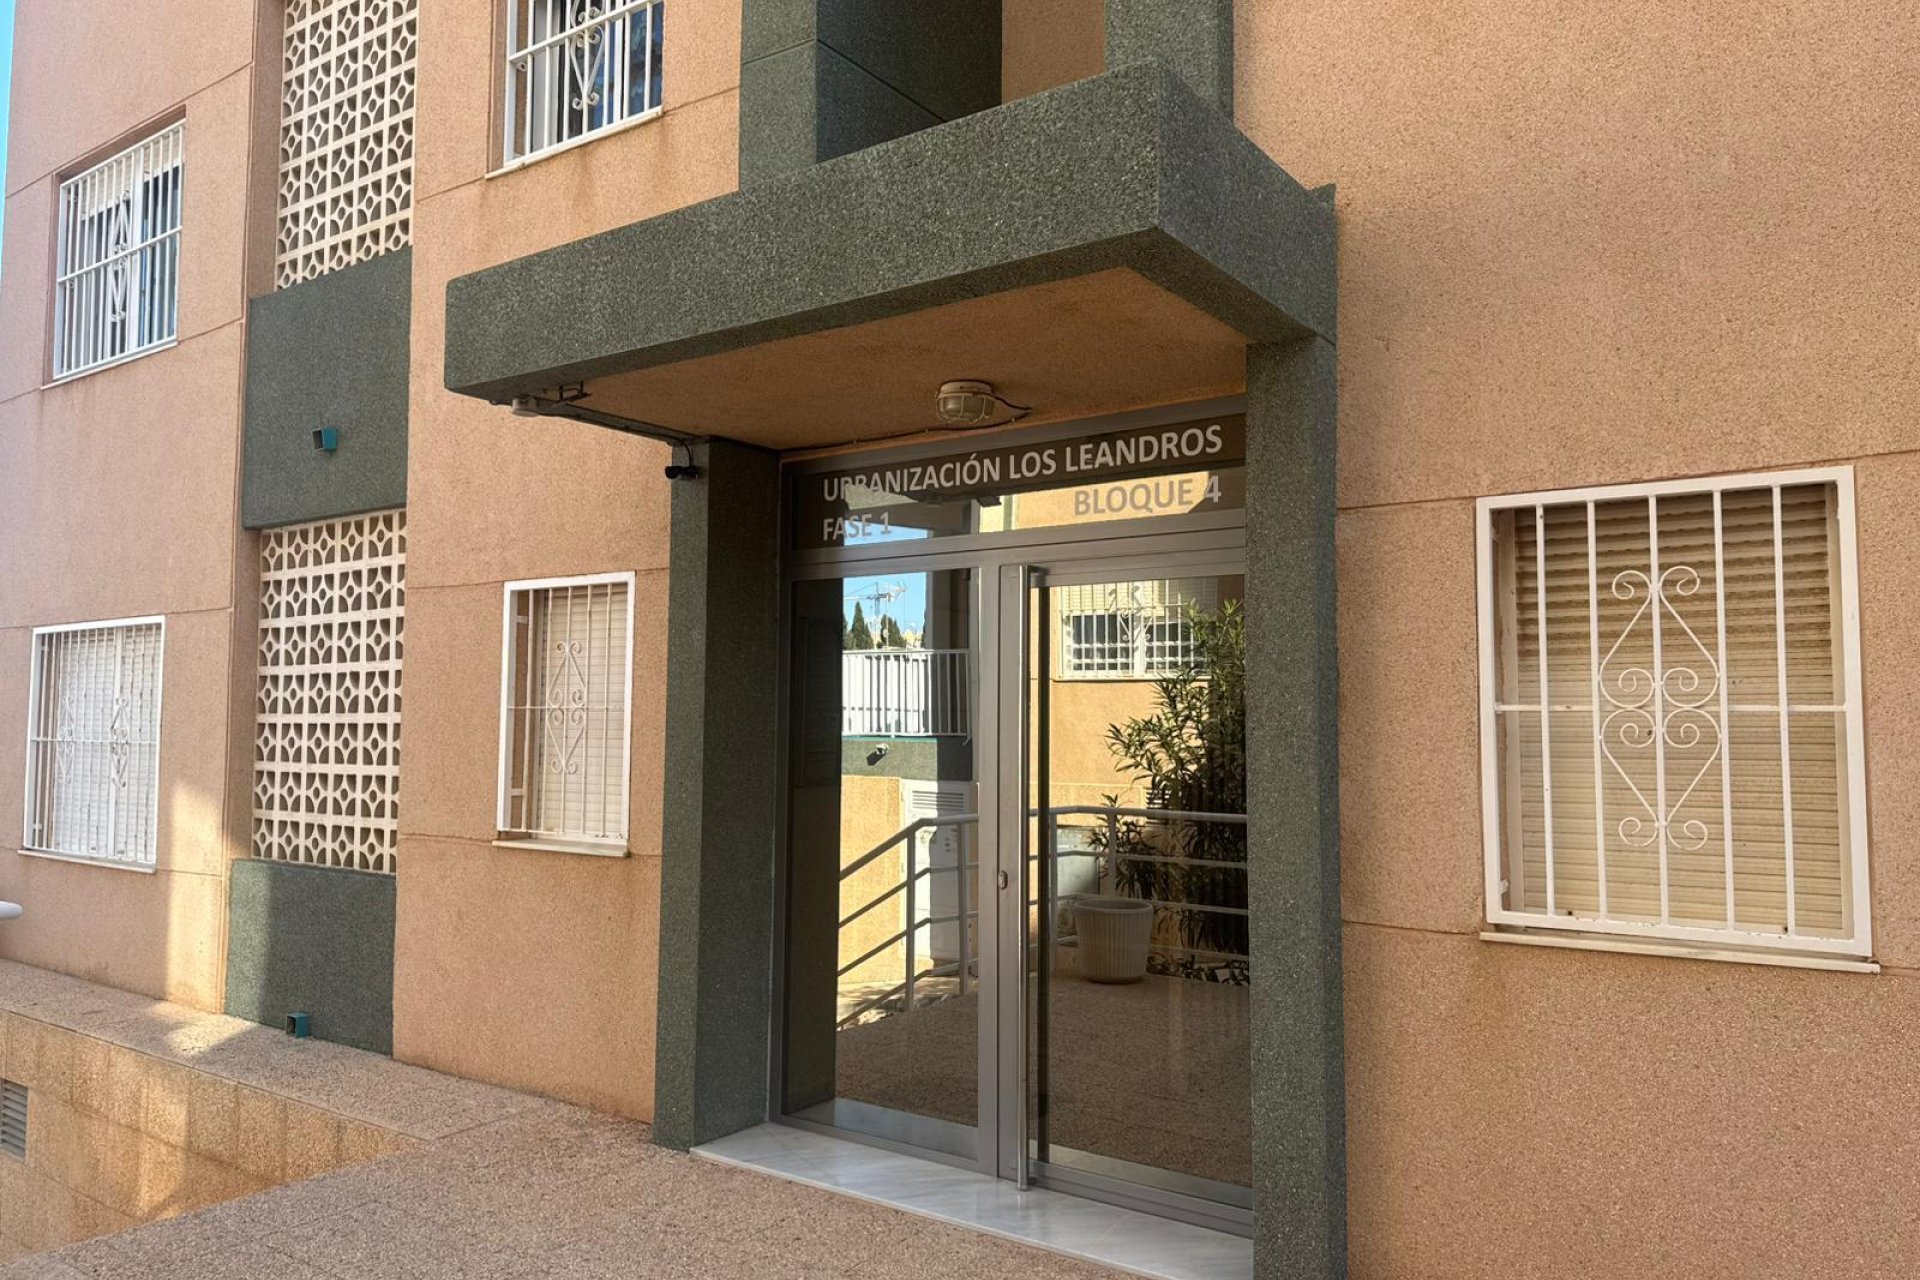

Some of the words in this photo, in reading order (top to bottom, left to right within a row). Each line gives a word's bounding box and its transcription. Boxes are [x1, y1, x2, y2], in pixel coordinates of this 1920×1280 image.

[1009, 449, 1056, 480] LOS
[1066, 424, 1223, 473] LEANDROS
[1075, 478, 1193, 516] BLOQUE
[1204, 475, 1221, 503] 4
[823, 513, 872, 541] FASE
[880, 511, 892, 535] 1
